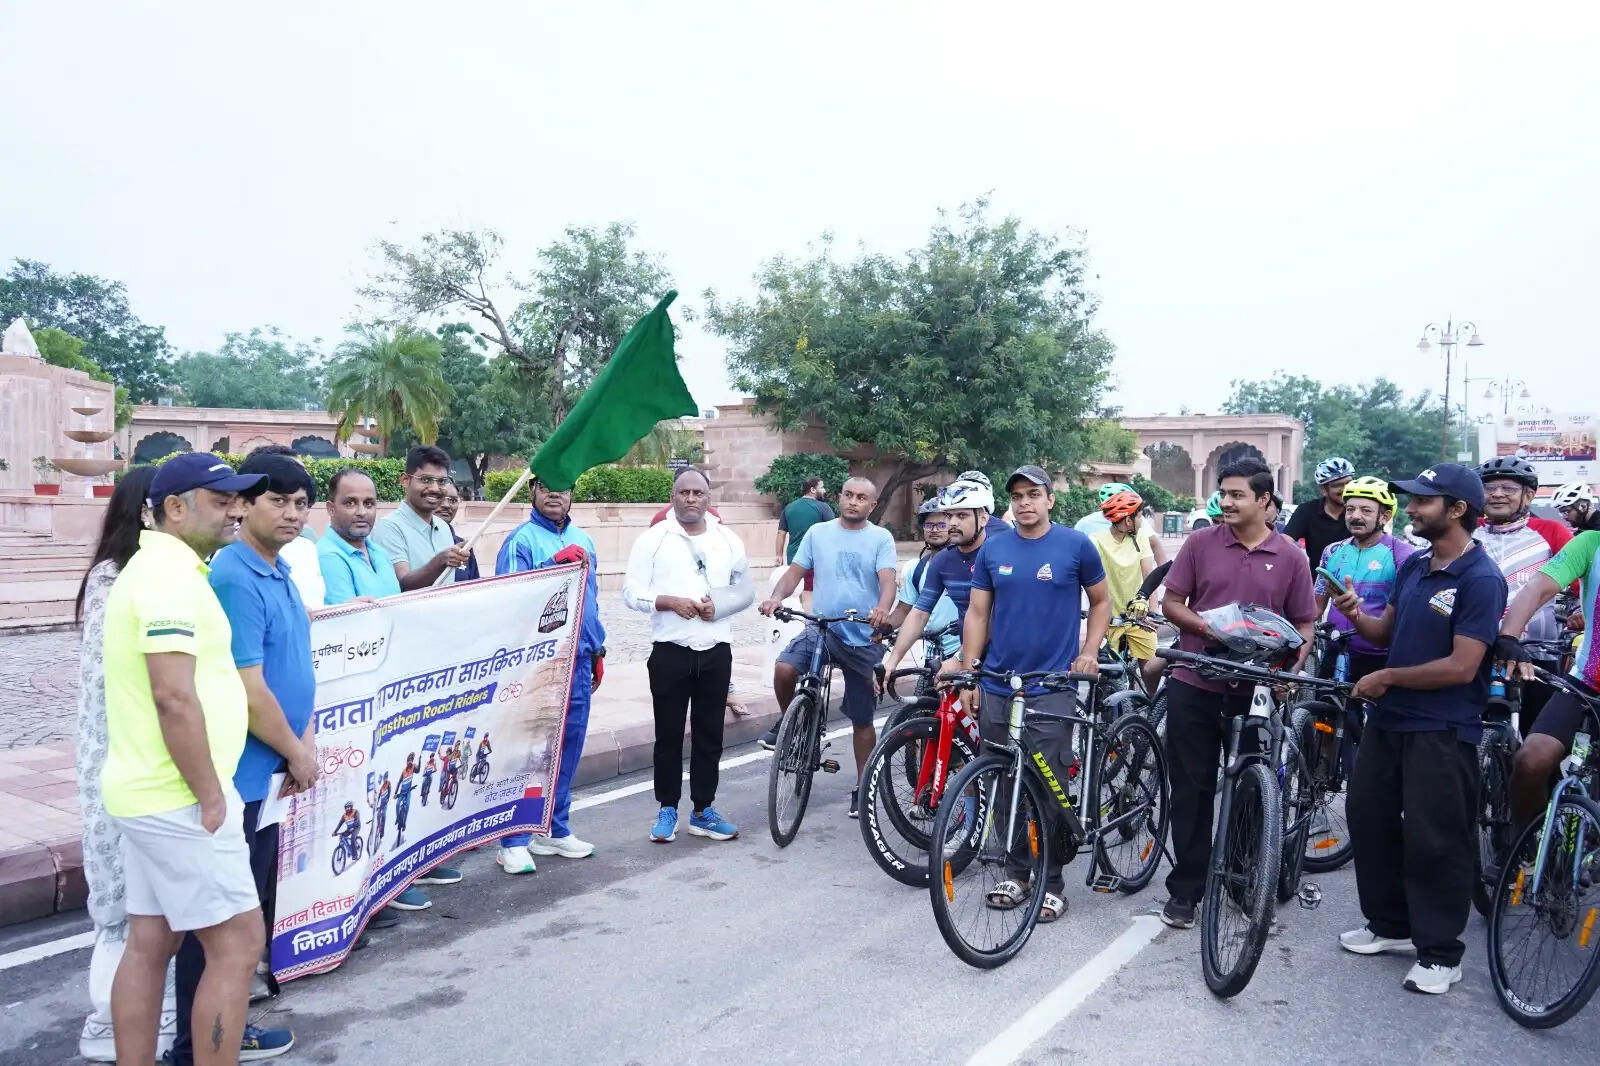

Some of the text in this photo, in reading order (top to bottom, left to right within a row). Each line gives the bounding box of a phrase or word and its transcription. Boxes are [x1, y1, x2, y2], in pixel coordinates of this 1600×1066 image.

[314, 697, 375, 735] दाता
[458, 647, 525, 684] साइकिल
[525, 639, 558, 664] राइड
[422, 699, 453, 720] Road
[455, 689, 489, 709] Riders
[867, 753, 906, 871] BONTRAGER
[291, 926, 340, 956] जिला
[394, 850, 420, 876] जयपुर
[426, 825, 466, 857] राजस्थान
[466, 818, 482, 835] रोड
[482, 804, 517, 829] राइडर्स
[312, 895, 355, 919] दिनांक
